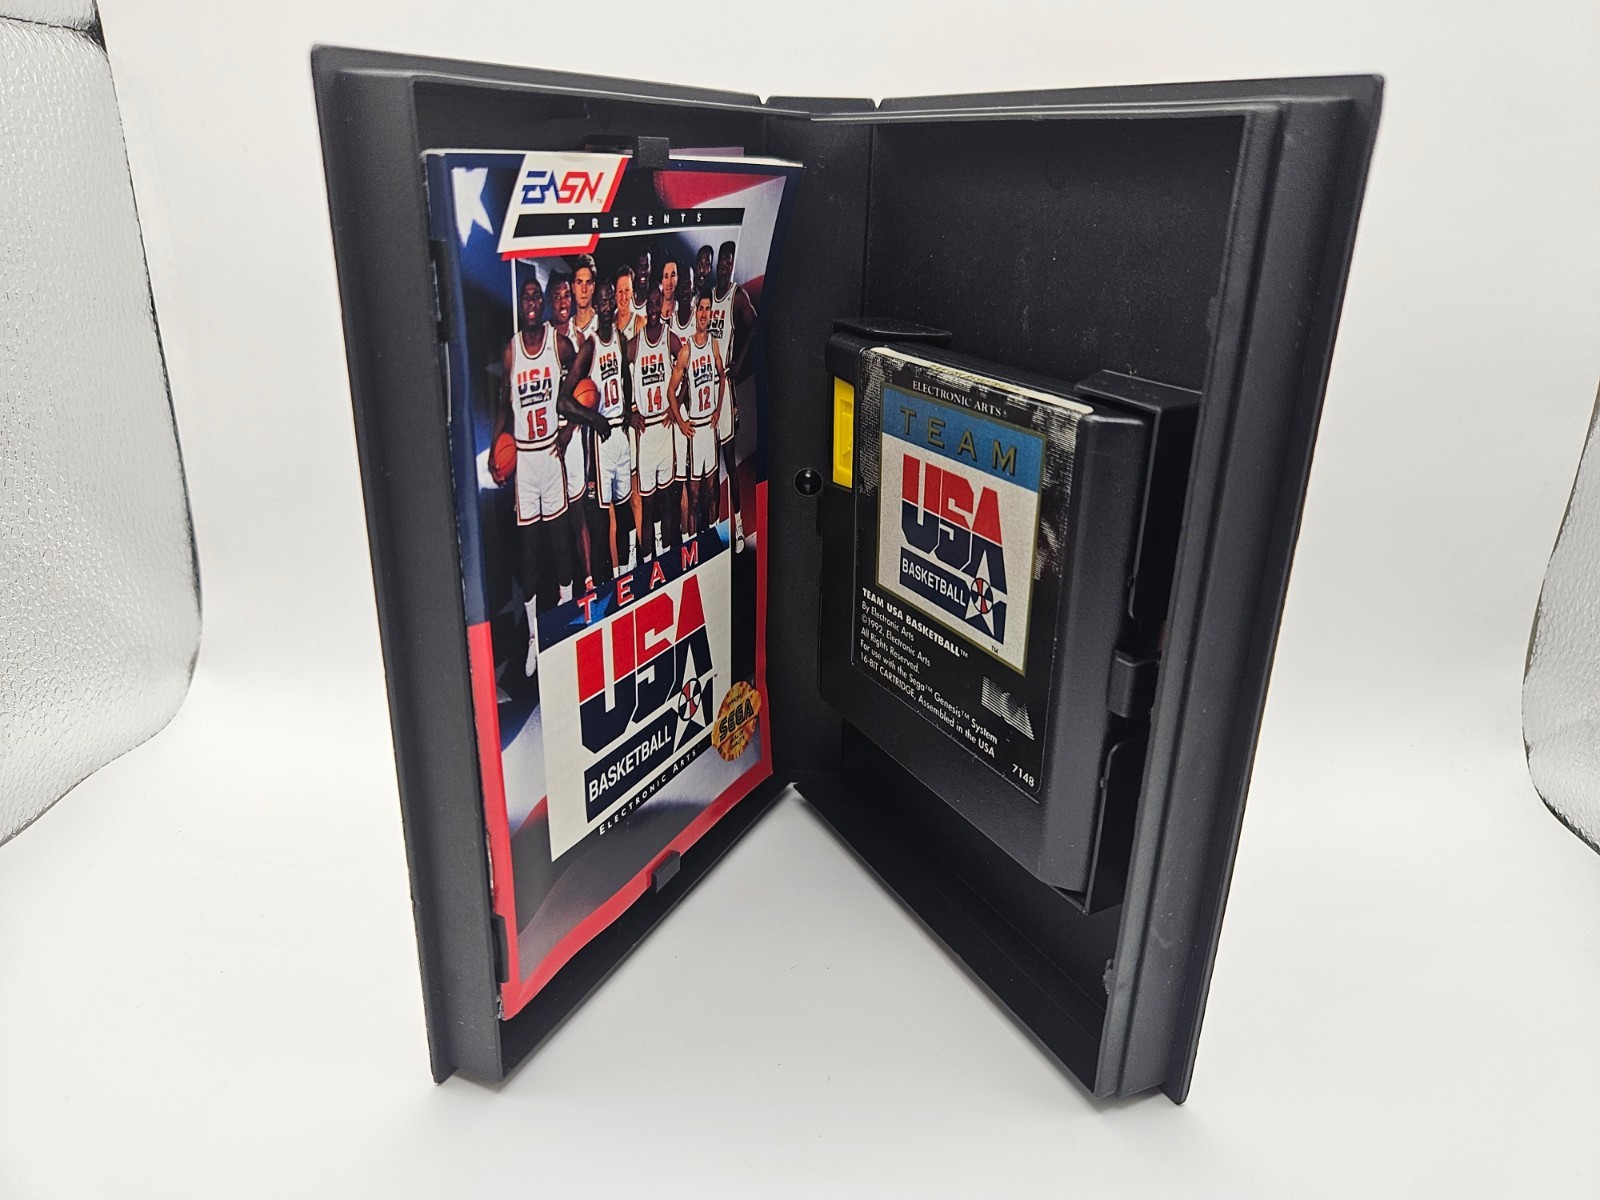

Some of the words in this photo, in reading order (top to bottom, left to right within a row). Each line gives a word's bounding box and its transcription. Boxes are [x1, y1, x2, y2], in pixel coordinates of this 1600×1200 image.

[568, 213, 702, 230] PRESENTS
[517, 367, 552, 396] USA
[599, 352, 618, 371] USA
[641, 353, 665, 376] USA
[692, 355, 712, 378] USA
[604, 379, 620, 408] 10
[647, 386, 662, 413] 14
[698, 386, 711, 412] 12
[912, 380, 972, 409] ELECTRONIC
[527, 407, 548, 440] 15
[900, 407, 1018, 476] TEAM
[902, 453, 1008, 620] USA
[577, 540, 699, 624] TEAM
[902, 557, 966, 607] BASKETBALL
[862, 587, 884, 608] TEAM
[886, 602, 903, 621] USA
[862, 601, 870, 612] By
[871, 605, 900, 631] Electronic
[901, 626, 914, 642] Arts
[861, 614, 885, 636] ©1992,
[886, 629, 915, 656] Electronic
[917, 650, 931, 667] Arts
[861, 626, 870, 639] All
[870, 633, 889, 653] Rights
[890, 644, 920, 674] Reserved.
[576, 573, 713, 754] USA
[860, 639, 870, 651] For
[871, 647, 882, 658] use
[883, 651, 896, 667] with
[897, 660, 908, 675] the
[971, 718, 998, 745] System
[860, 651, 878, 672] 16-BIT
[879, 666, 917, 701] CARTRIDGE,
[917, 695, 955, 727] Assembled
[956, 722, 963, 733] in
[964, 727, 977, 743] the
[978, 738, 995, 758] USA
[719, 698, 755, 742] SEGA
[588, 724, 672, 802] BASKETBALL
[1012, 763, 1035, 787] 7148
[599, 774, 667, 836] ELECTRONIC
